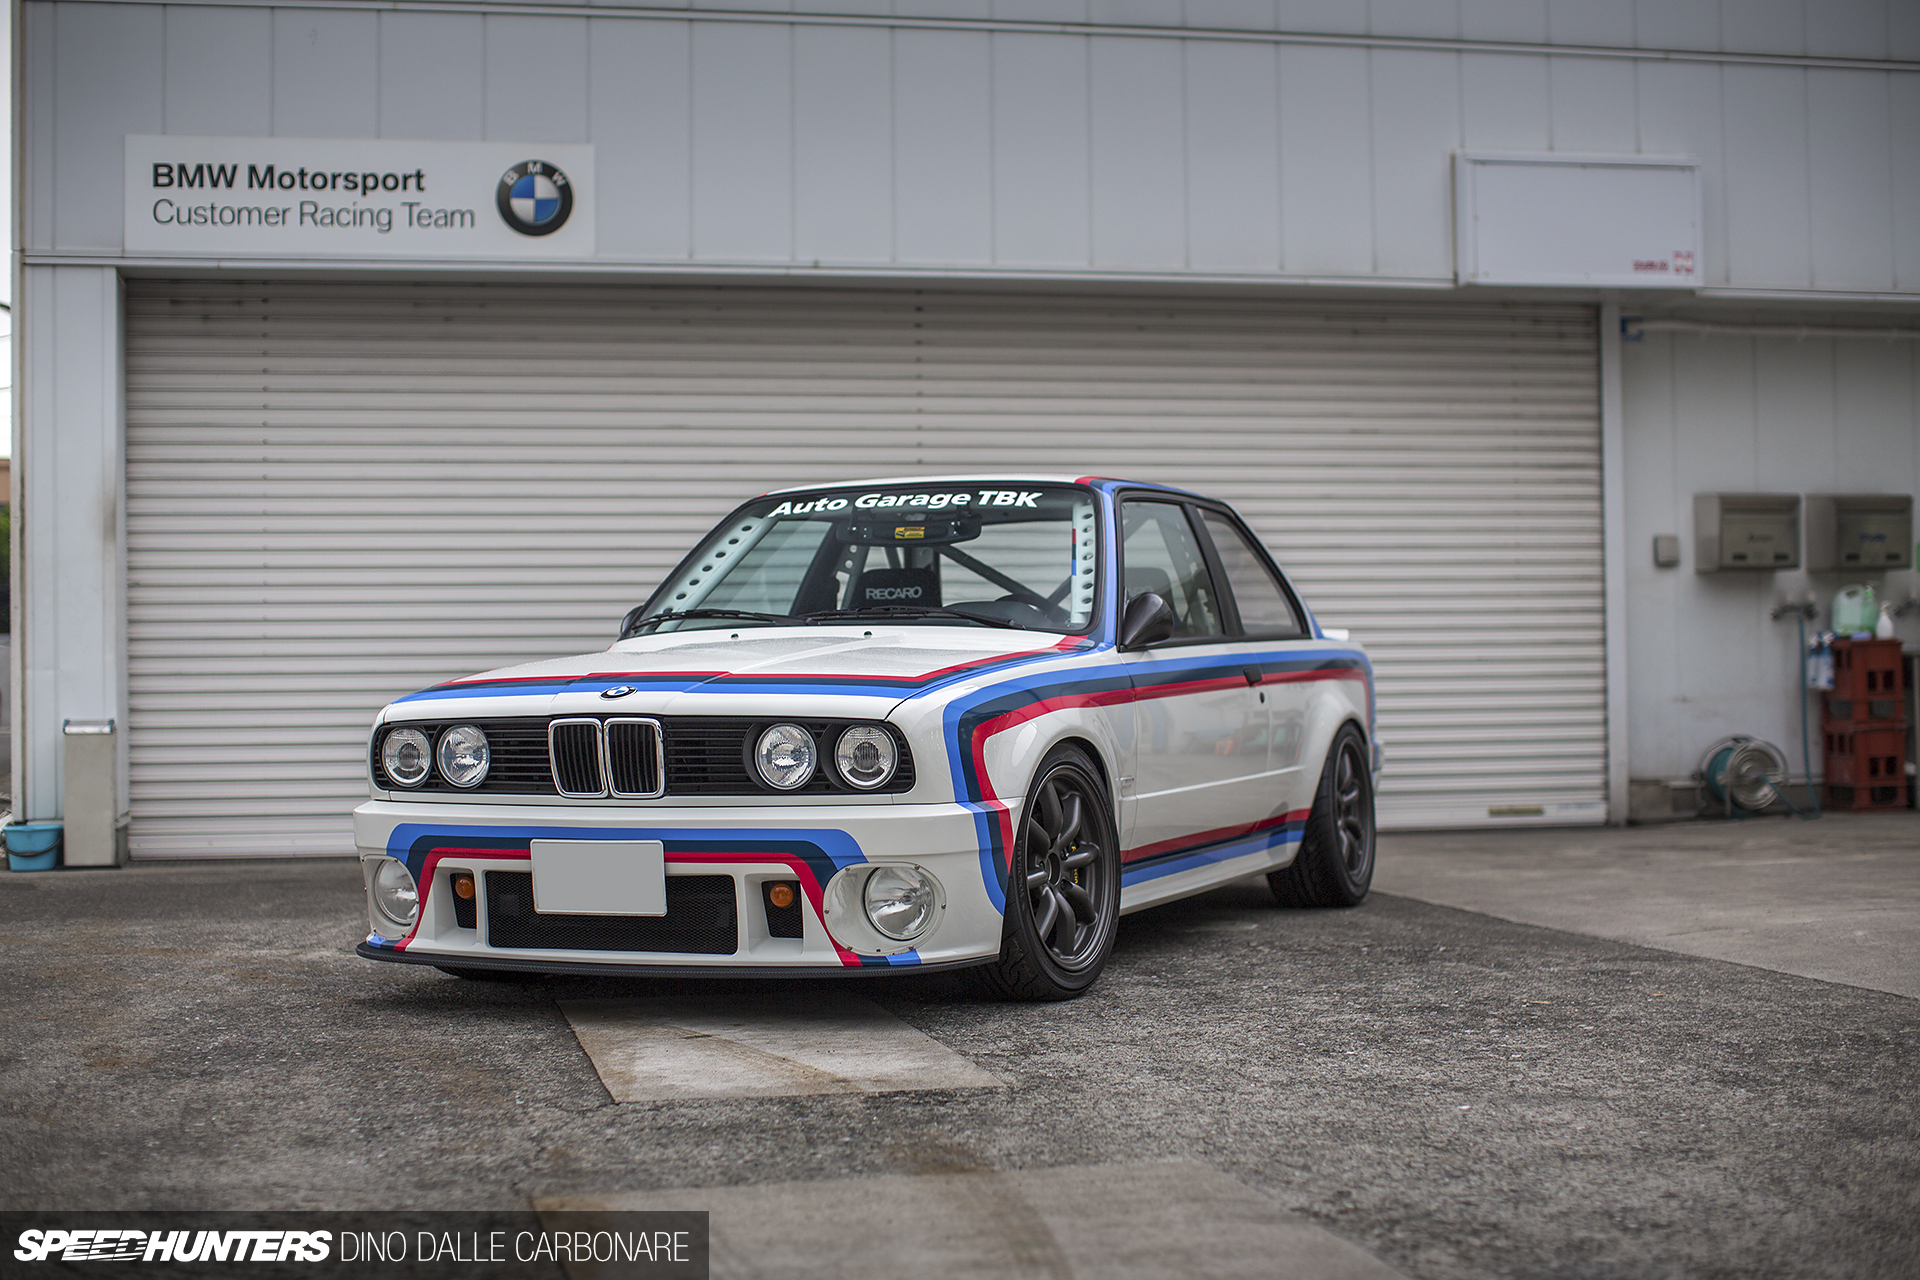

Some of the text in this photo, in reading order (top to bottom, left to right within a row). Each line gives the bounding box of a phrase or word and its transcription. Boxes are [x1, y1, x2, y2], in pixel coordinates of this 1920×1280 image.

[152, 162, 426, 197] BMW Motorsport
[502, 161, 567, 188] BMW
[152, 198, 476, 234] Customer Racing Team
[767, 490, 1043, 518] Auto Garage TBK
[865, 586, 922, 600] RECARO
